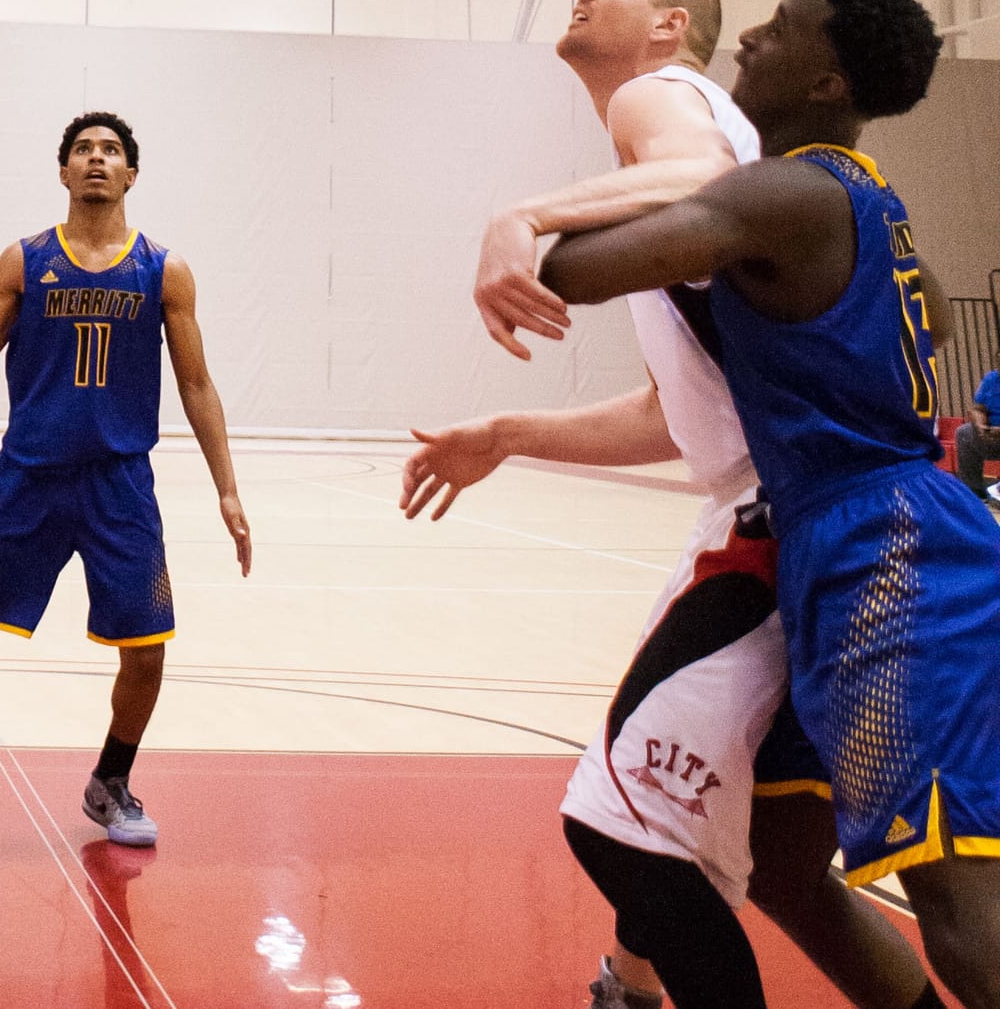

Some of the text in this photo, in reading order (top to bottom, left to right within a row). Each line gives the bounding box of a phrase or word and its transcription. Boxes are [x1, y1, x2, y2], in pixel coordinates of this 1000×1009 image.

[45, 287, 145, 320] MERRITT
[74, 322, 111, 387] 11
[646, 738, 721, 796] CITY
